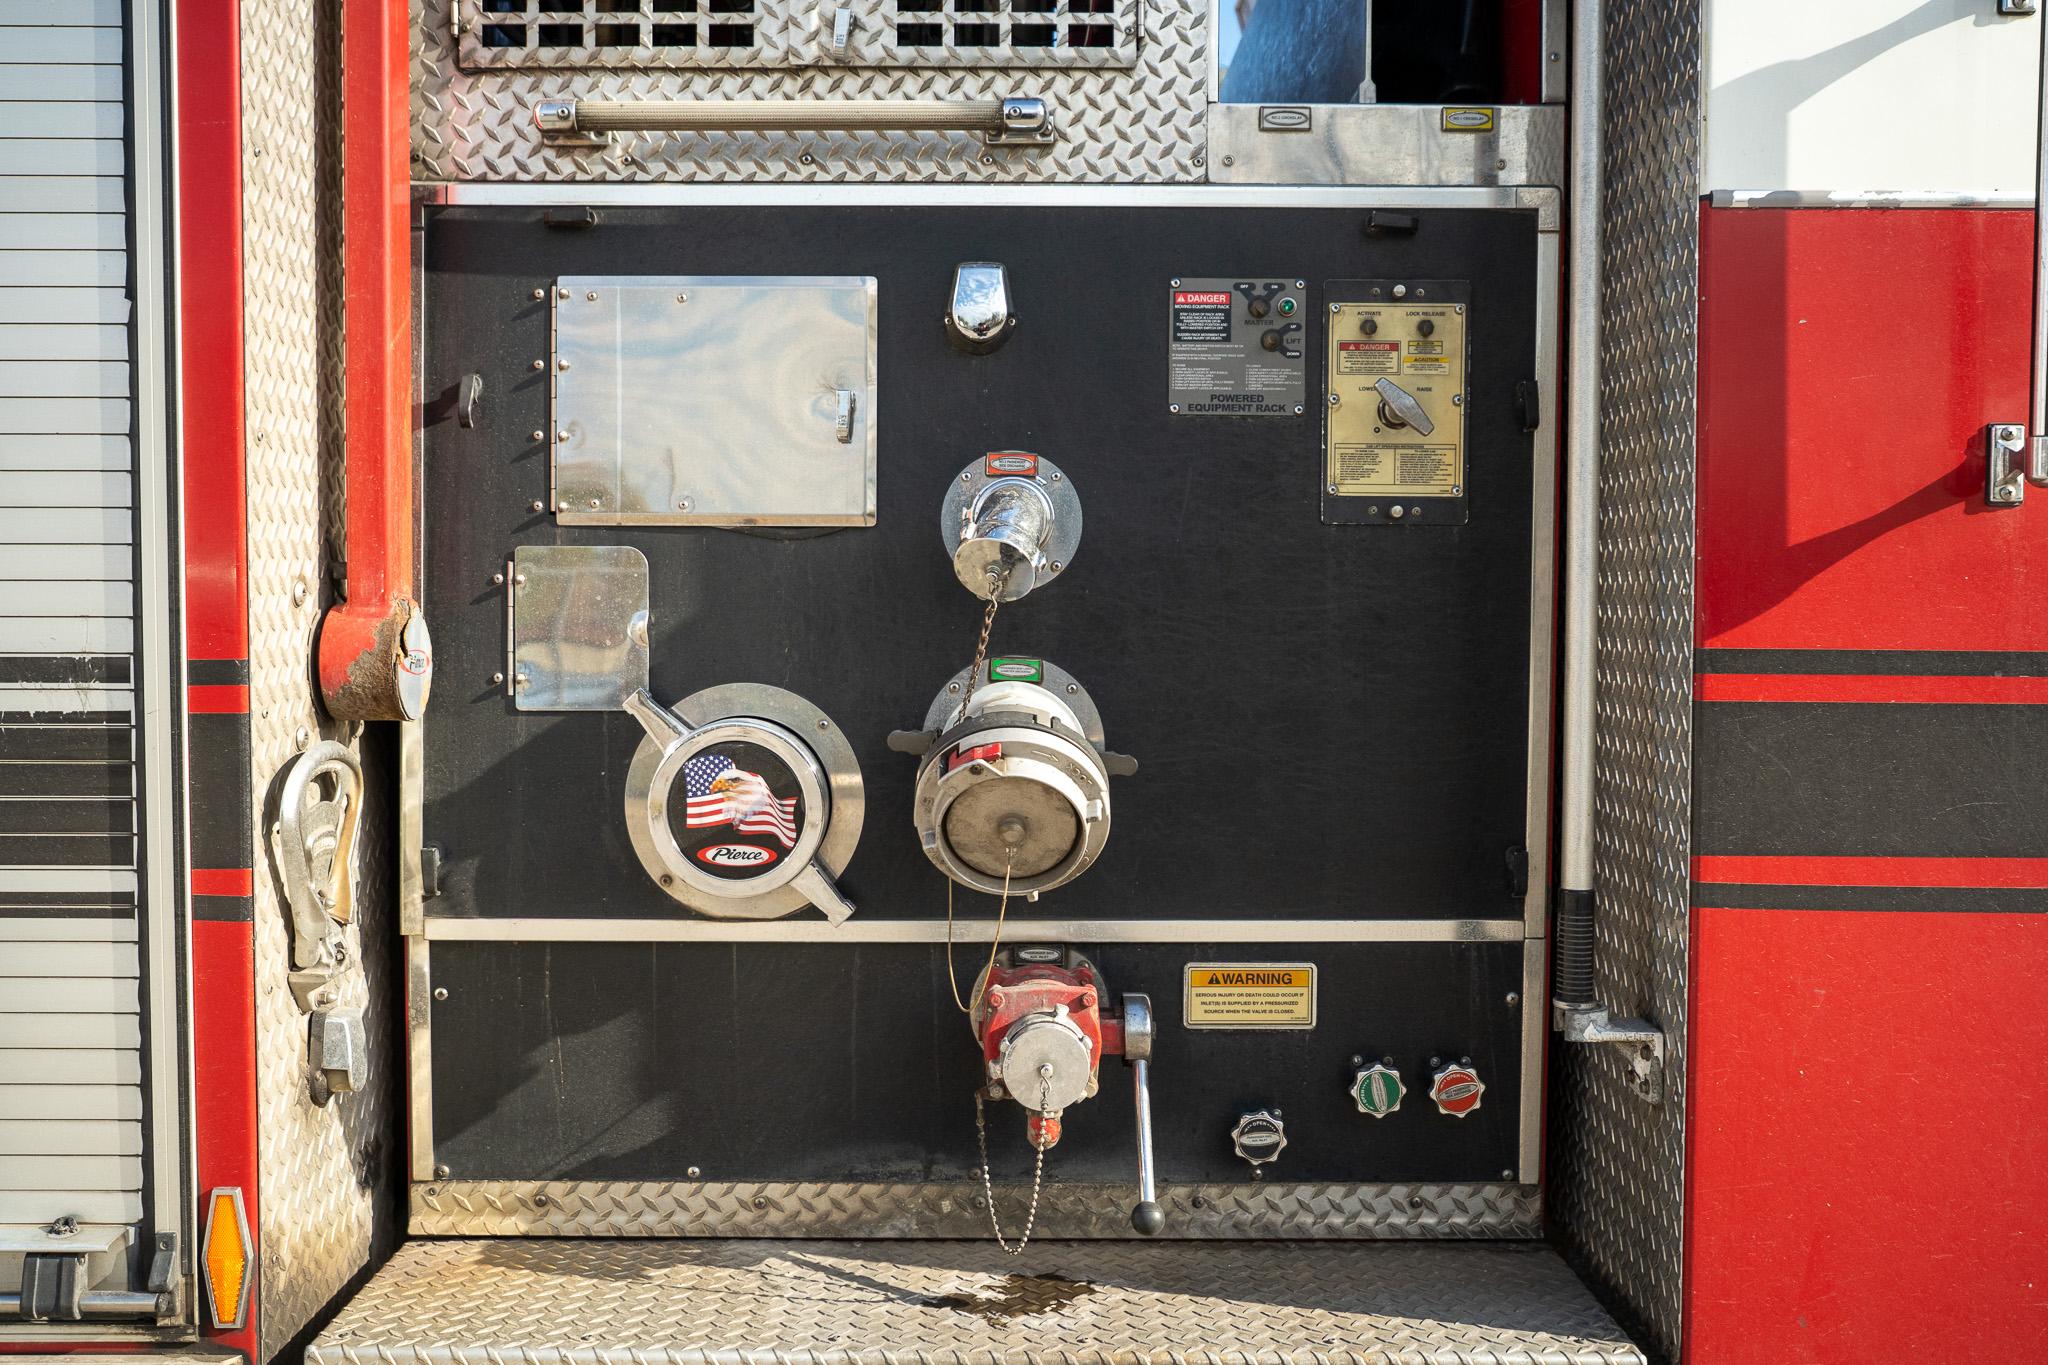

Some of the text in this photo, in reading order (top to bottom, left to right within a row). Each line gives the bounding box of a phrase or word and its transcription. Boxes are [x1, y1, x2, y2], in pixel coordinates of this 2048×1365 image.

[1211, 394, 1264, 402] POWERED
[1188, 404, 1286, 412] EQUIPMENT RACK
[712, 848, 763, 861] Pierce
[1222, 973, 1292, 984] WARNING
